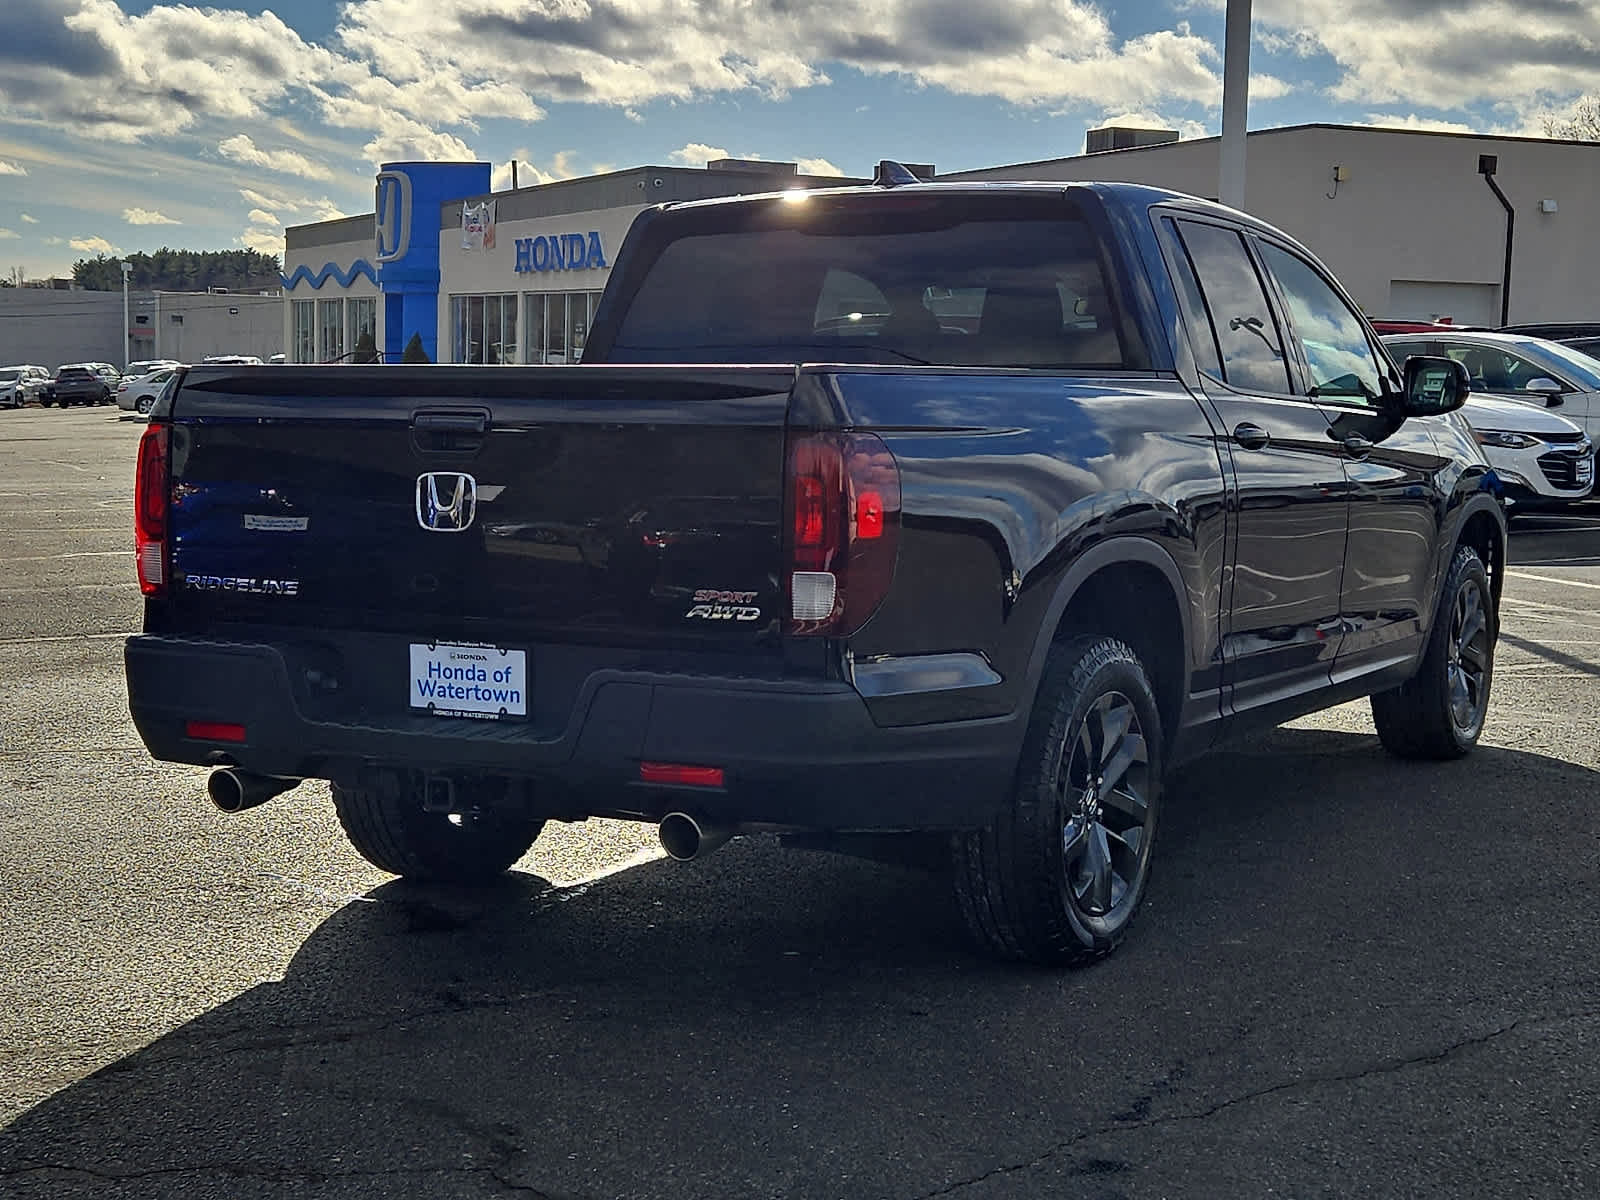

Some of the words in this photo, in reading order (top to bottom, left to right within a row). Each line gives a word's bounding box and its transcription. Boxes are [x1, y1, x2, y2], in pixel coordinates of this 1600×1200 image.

[514, 231, 607, 273] HONDA
[185, 575, 299, 595] RIDGELINE
[693, 590, 758, 603] SPORT
[685, 604, 761, 621] AWD
[456, 653, 488, 661] HONDA
[428, 661, 487, 681] Honda
[493, 666, 511, 683] of
[417, 679, 520, 703] Watertown
